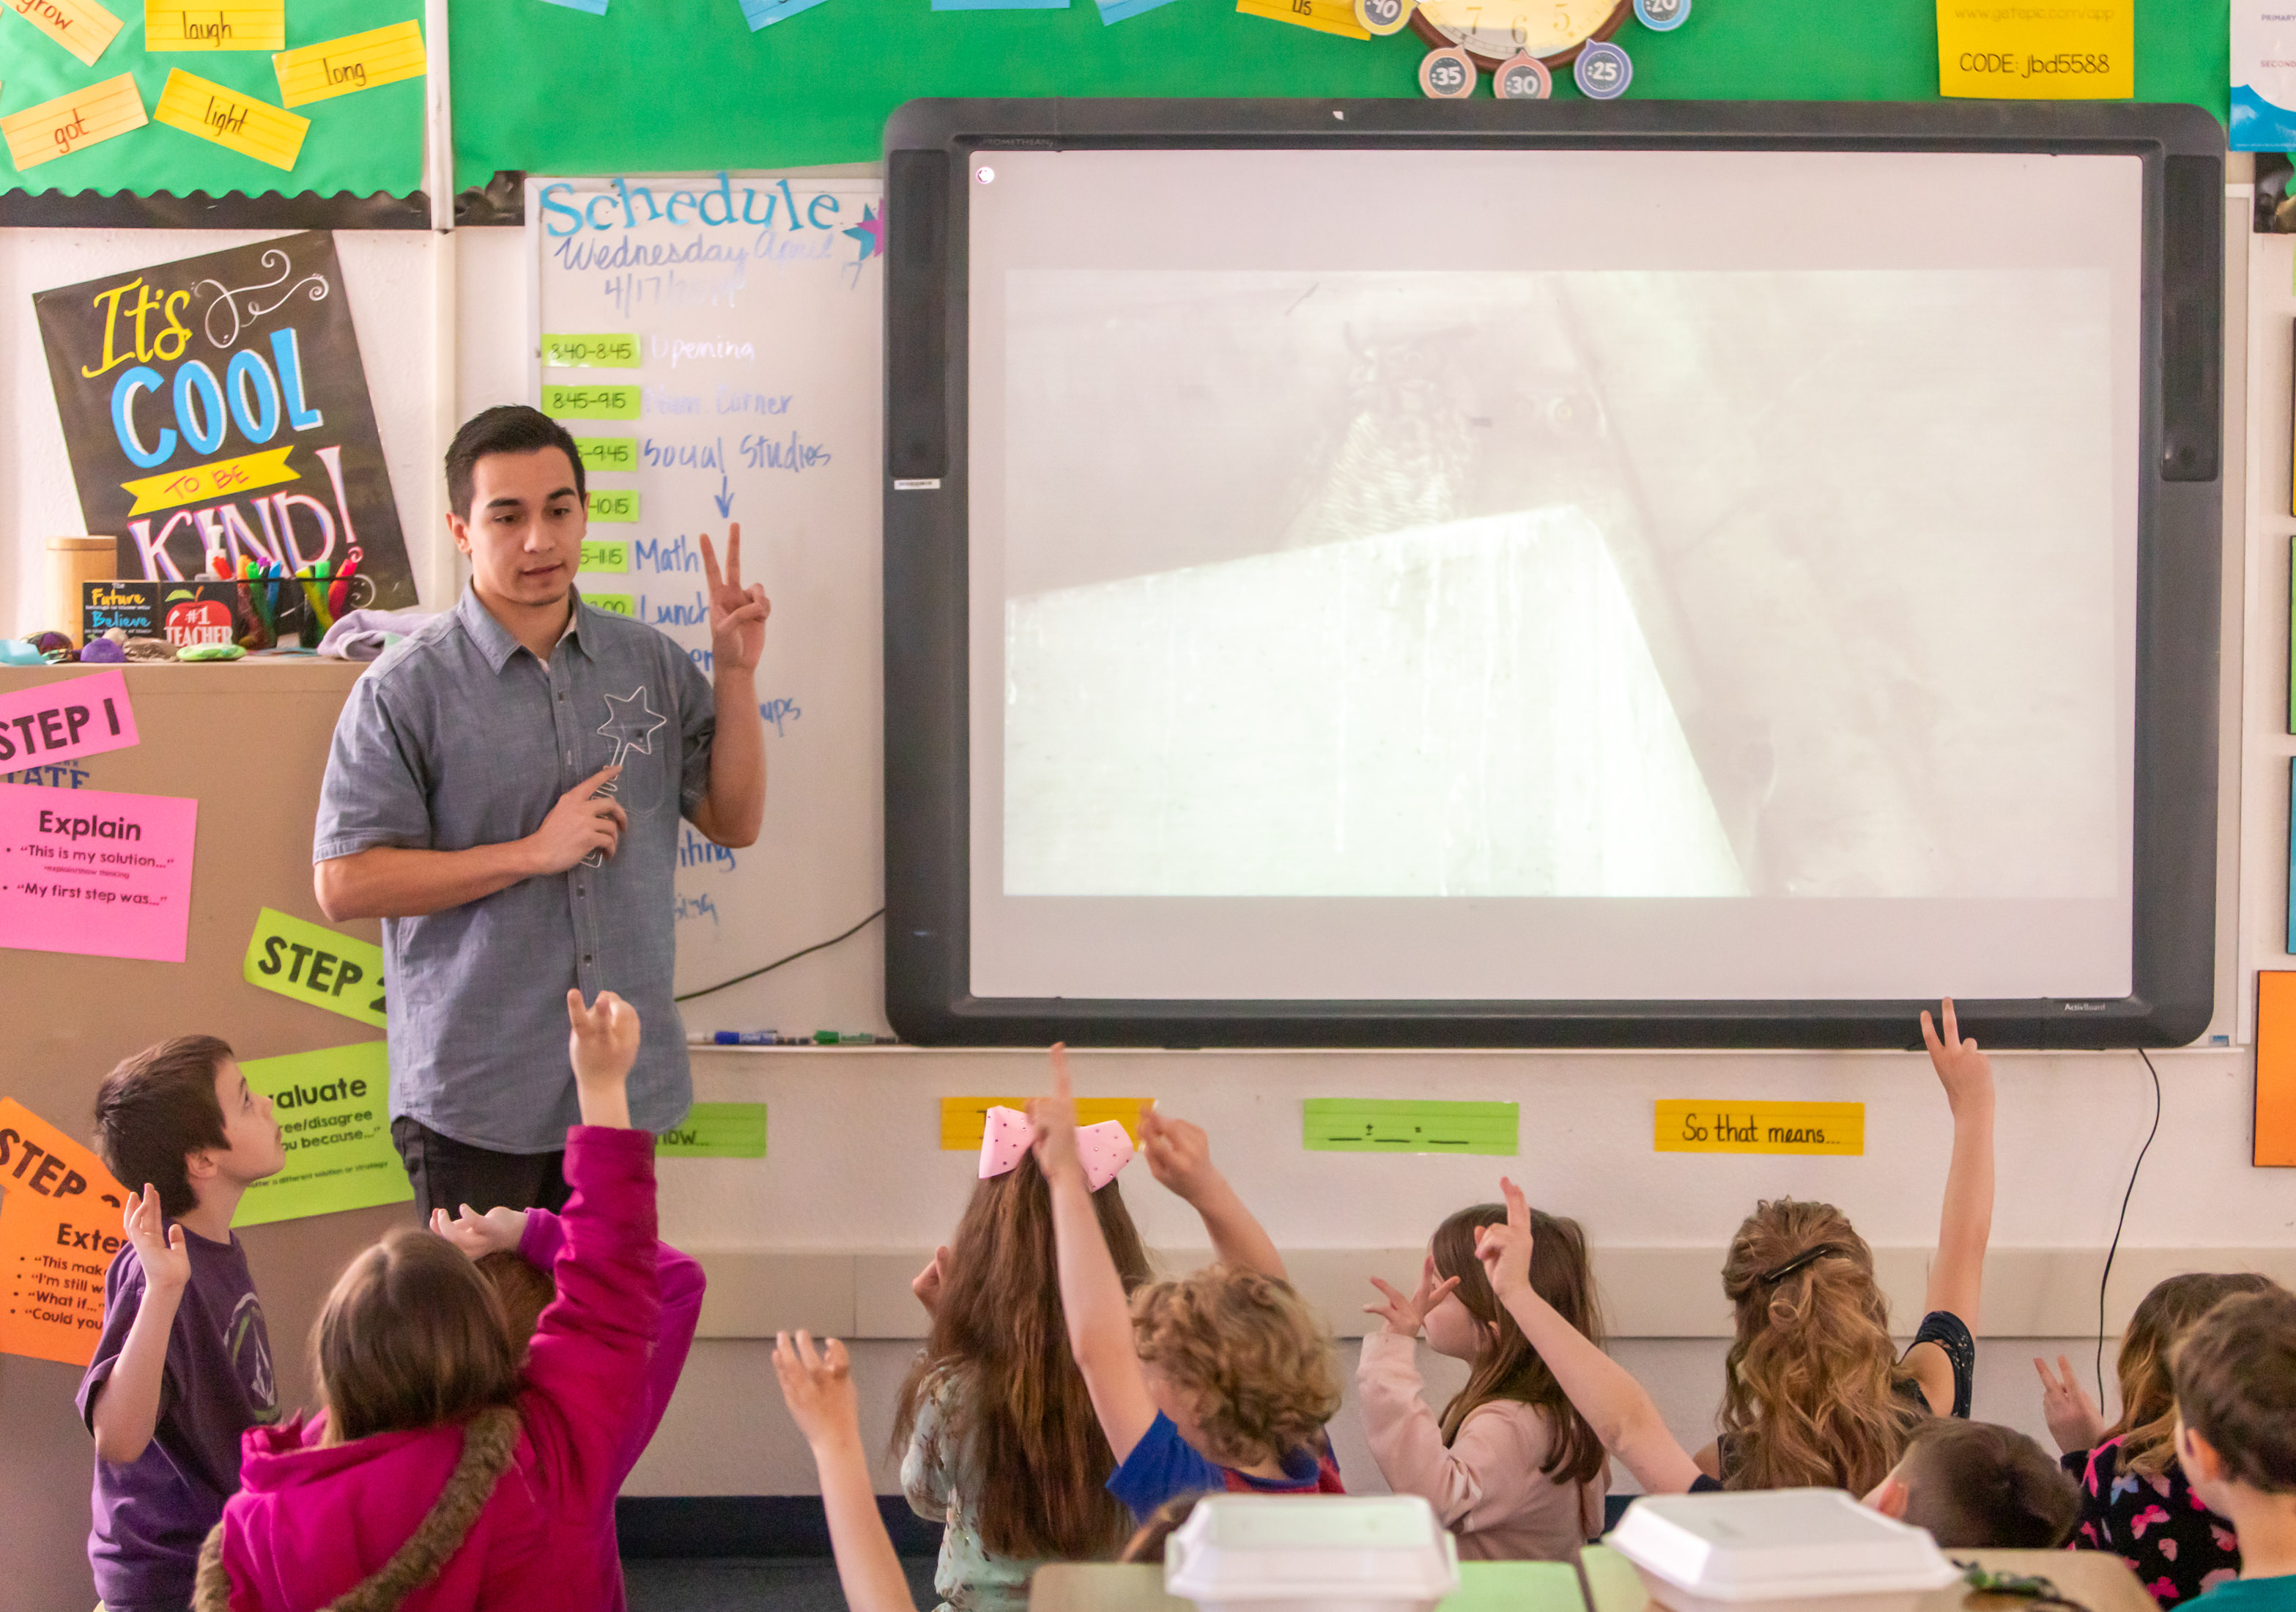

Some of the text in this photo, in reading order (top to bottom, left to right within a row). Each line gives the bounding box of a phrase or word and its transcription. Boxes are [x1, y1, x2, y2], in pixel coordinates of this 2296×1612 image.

[16, 0, 73, 30] grow
[182, 10, 232, 47] laugh
[1466, 6, 1483, 35] 7
[1511, 14, 1527, 44] 6
[323, 58, 367, 87] long
[1960, 53, 2111, 79] CODE: jbd5588
[53, 108, 89, 154] got
[204, 96, 249, 137] light
[540, 172, 840, 237] Schedule
[554, 233, 747, 289] Wednesday
[81, 276, 193, 379] It's
[111, 327, 324, 468] COOL
[643, 431, 832, 475] Social Studies
[163, 464, 250, 500] TO BE
[634, 534, 700, 574] Math
[92, 588, 145, 605] Future
[92, 610, 152, 627] Believe
[184, 606, 211, 624] #1
[163, 626, 233, 648] TEACHER
[0, 705, 89, 761] STEP
[39, 810, 141, 841] Explain
[59, 847, 69, 859] is
[73, 852, 96, 865] my
[52, 885, 81, 899] first
[85, 888, 116, 904] step
[258, 936, 363, 997] STEP
[2064, 1002, 2106, 1012] ActivBoard
[267, 1078, 367, 1110] aluate
[1683, 1113, 1841, 1145] So that means...
[0, 1128, 87, 1198] STEP
[72, 1262, 107, 1276] mak
[64, 1279, 87, 1292] still
[77, 1318, 103, 1330] you
